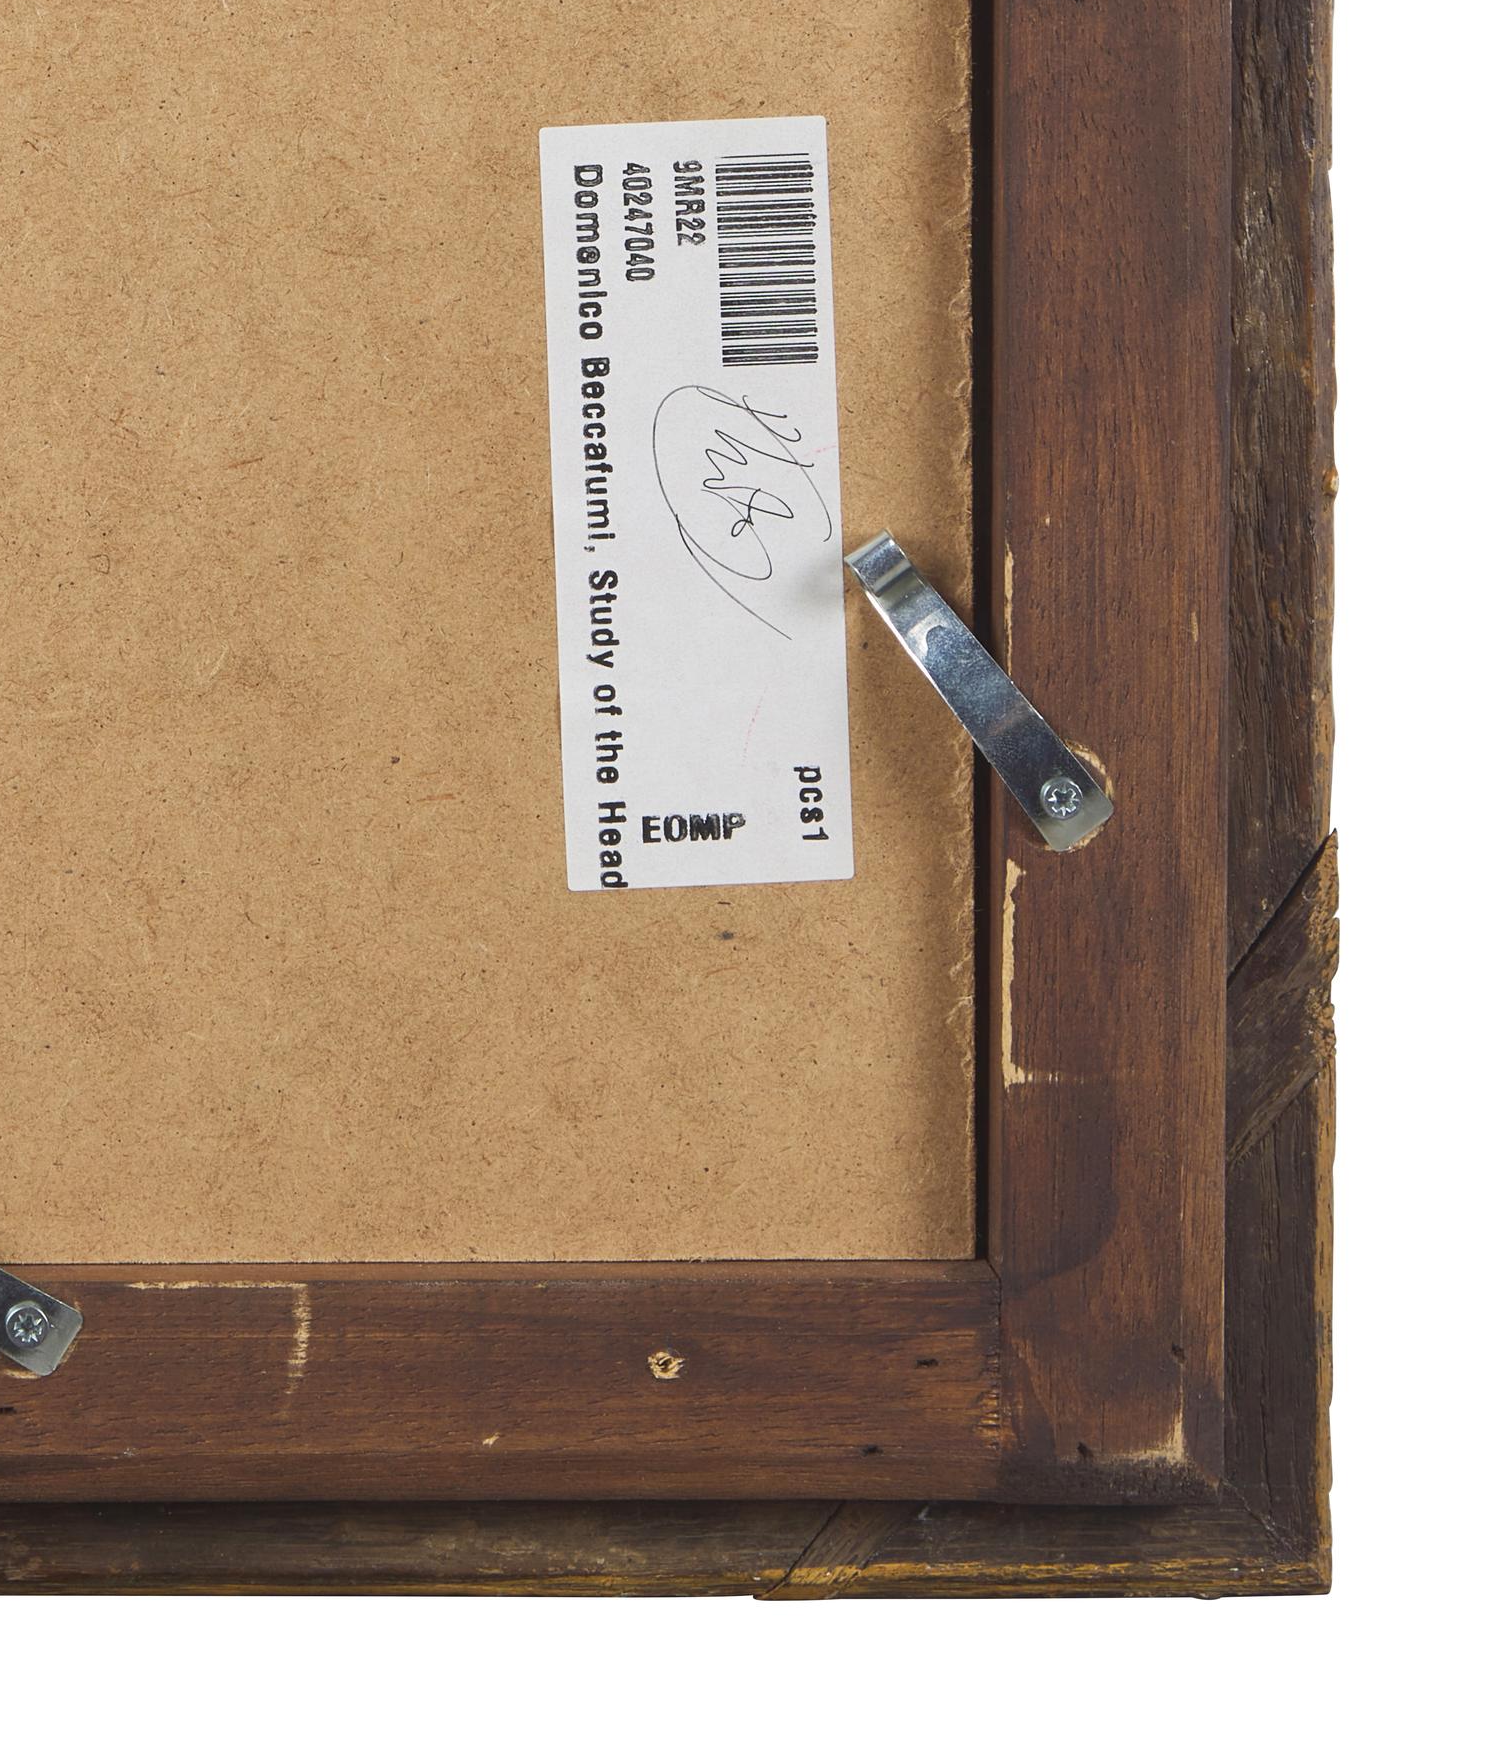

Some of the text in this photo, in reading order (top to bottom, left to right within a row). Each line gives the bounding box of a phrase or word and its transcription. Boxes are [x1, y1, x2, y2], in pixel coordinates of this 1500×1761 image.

[622, 163, 655, 281] 40247040
[673, 161, 705, 246] 9MR22
[574, 165, 628, 888] Domenico Beccafumi, Study of the Head
[794, 767, 829, 840] pcs1
